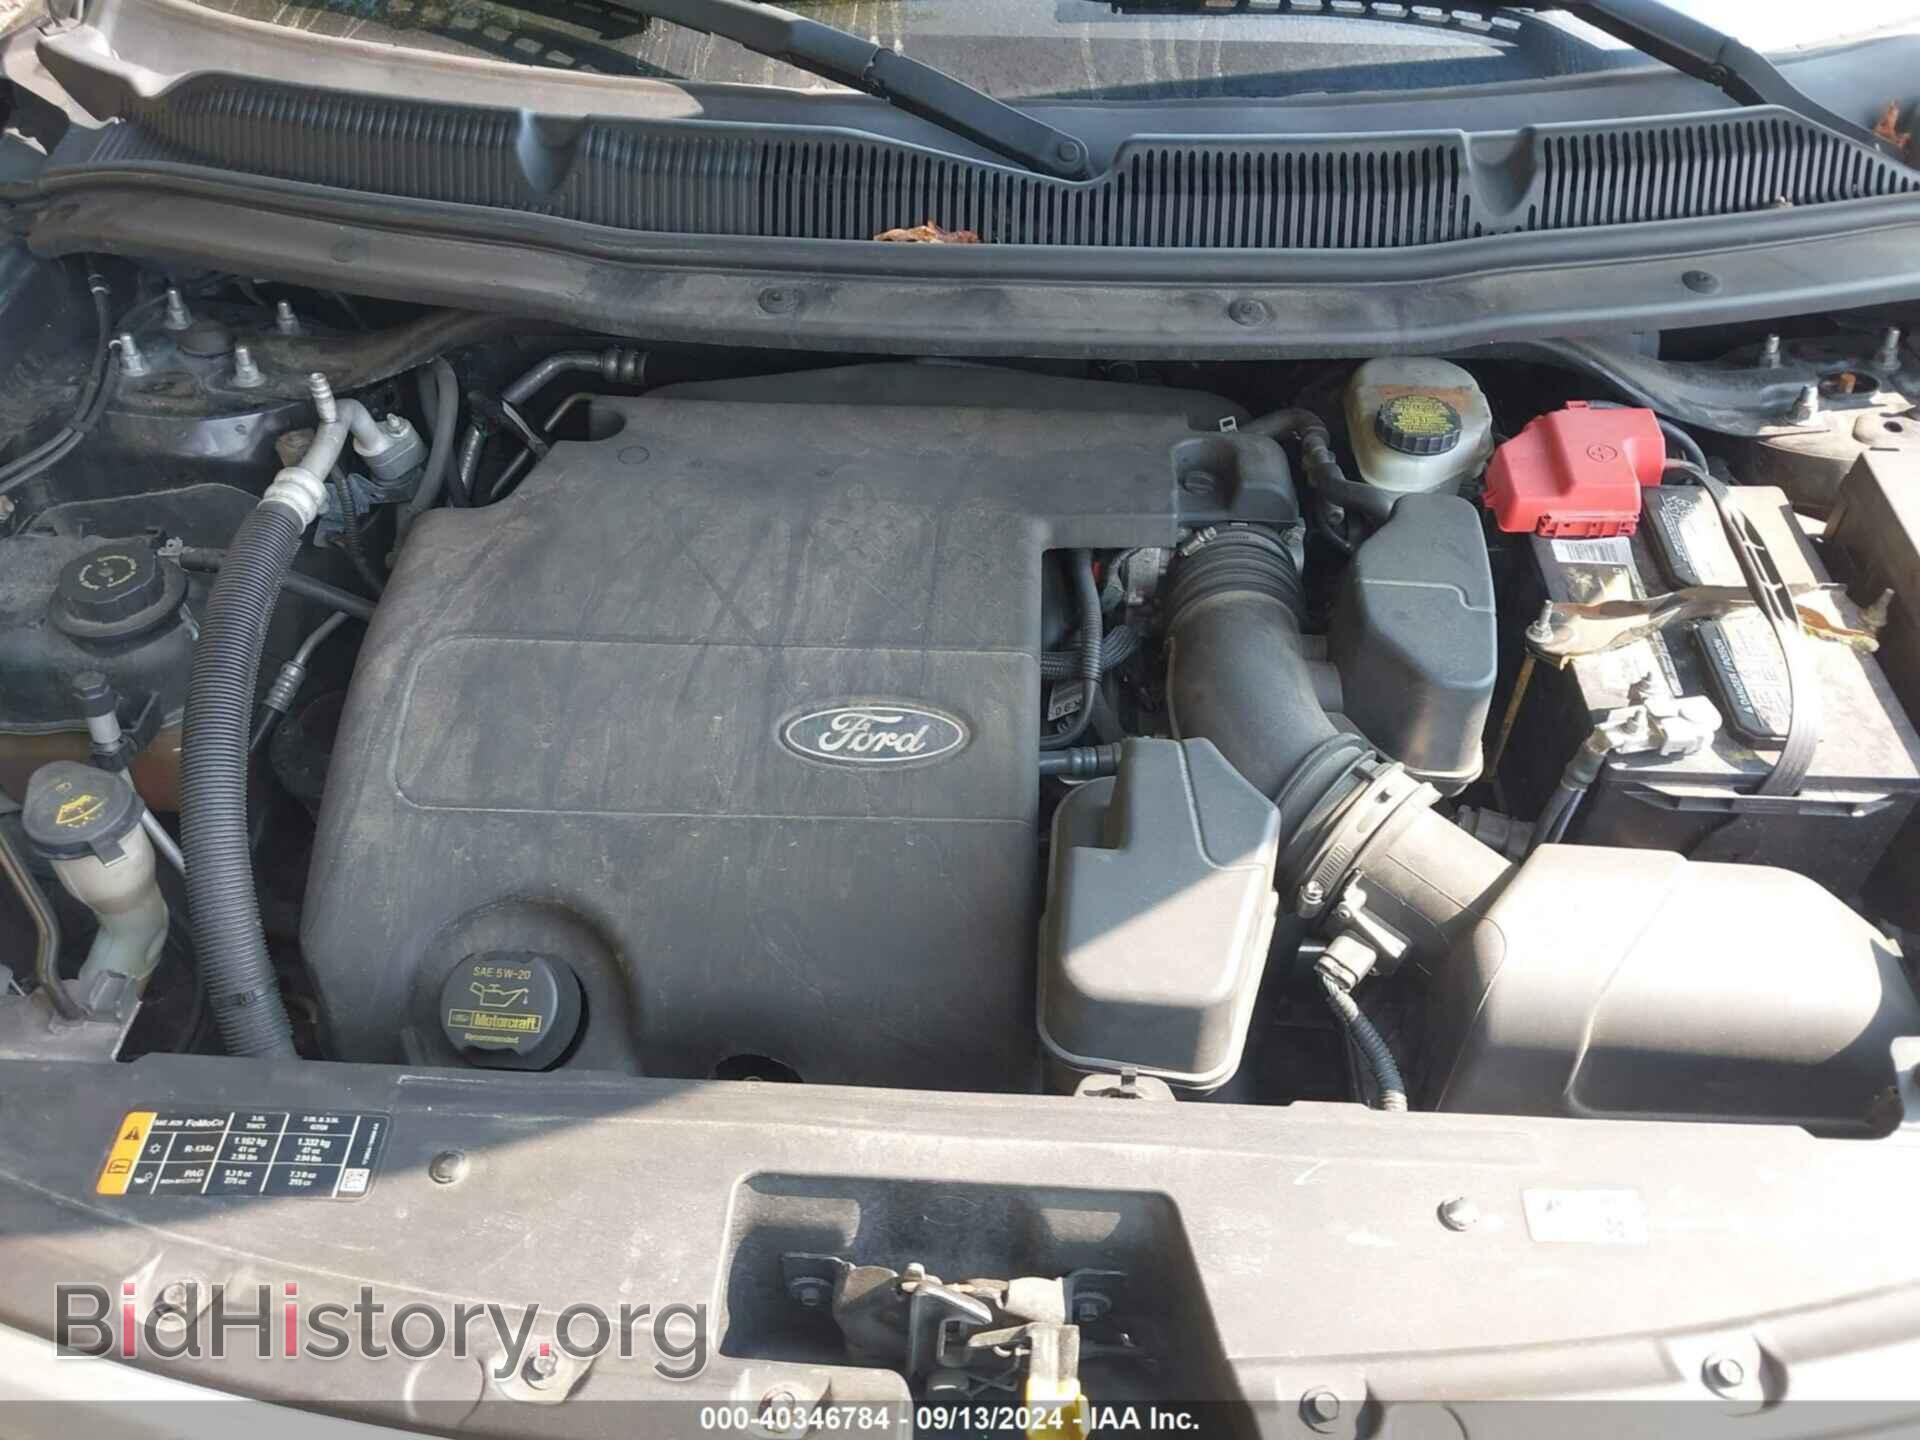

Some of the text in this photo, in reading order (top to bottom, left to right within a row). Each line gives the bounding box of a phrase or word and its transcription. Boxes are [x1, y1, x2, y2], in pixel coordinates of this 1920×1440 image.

[1728, 673, 1751, 705] DANGER
[818, 713, 930, 753] Ford
[472, 966, 532, 980] SAE 5W-20
[474, 1013, 537, 1030] Motorcraft
